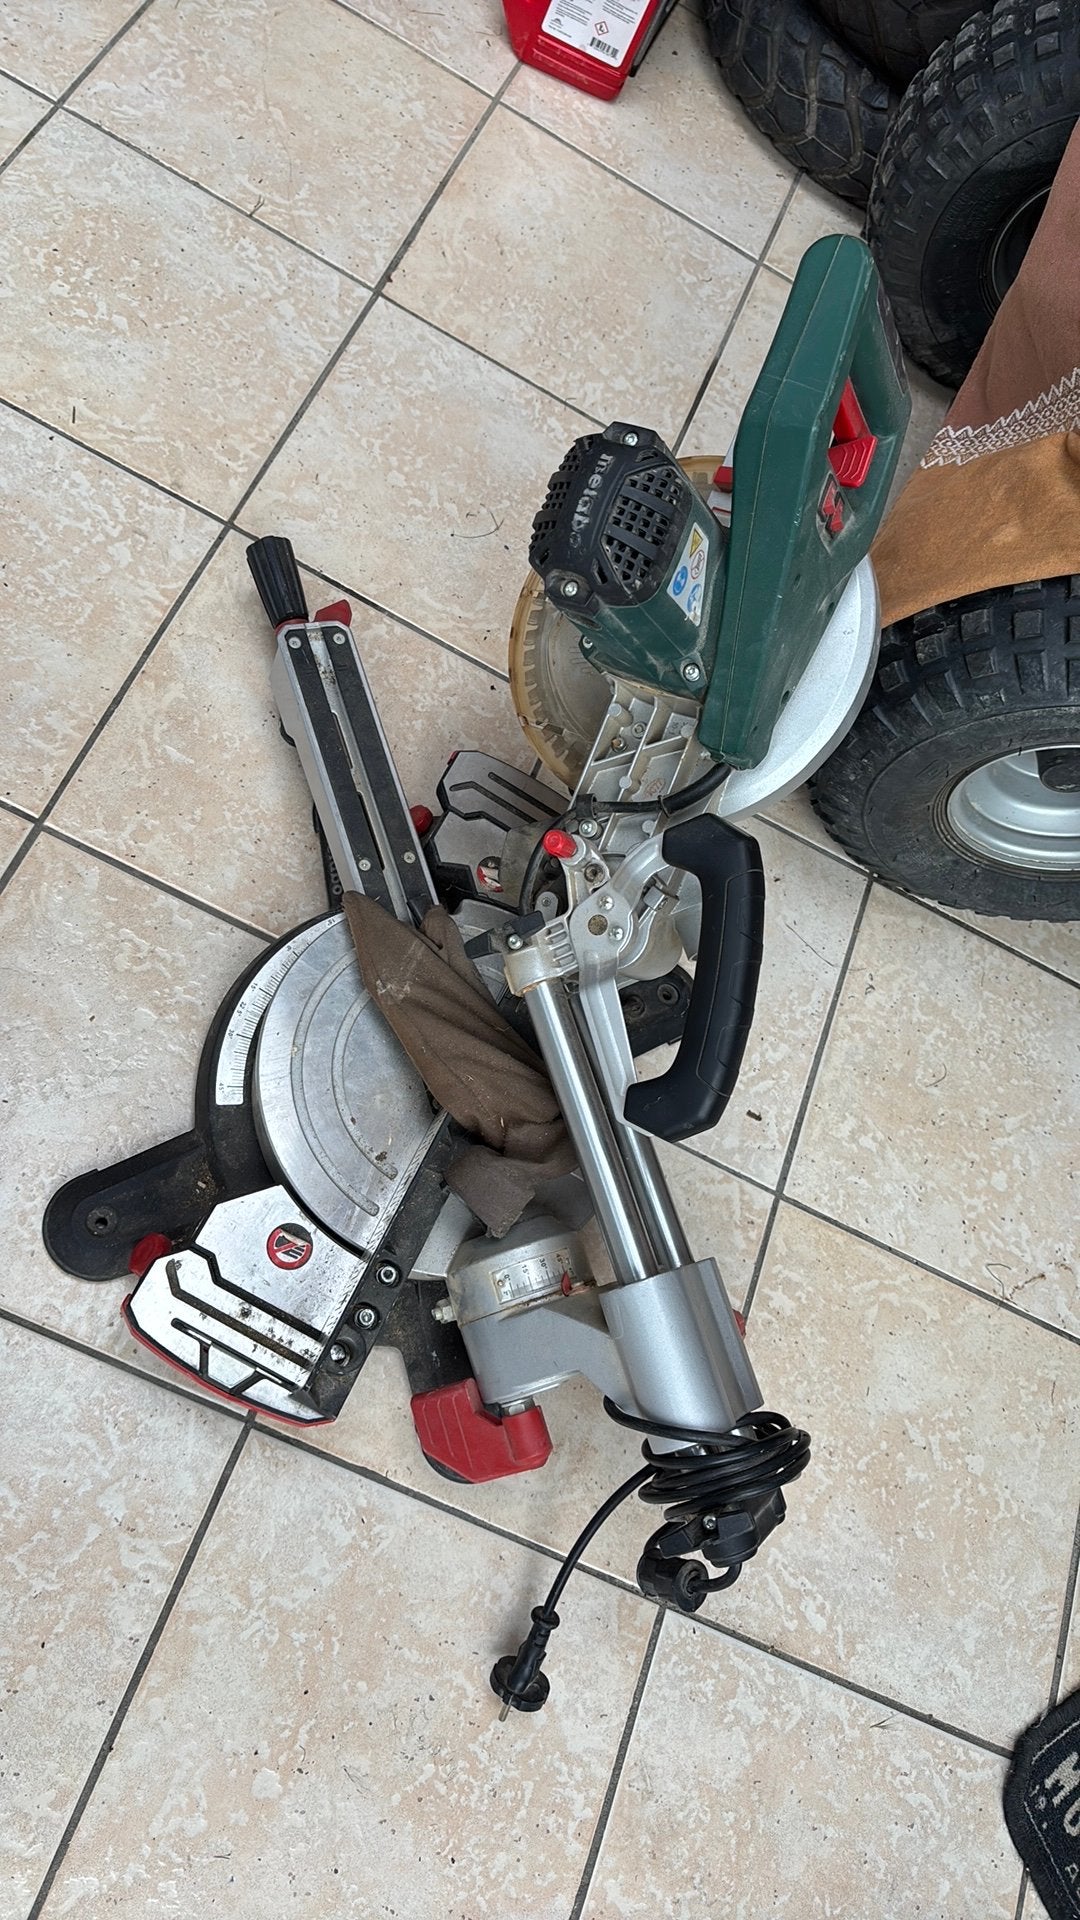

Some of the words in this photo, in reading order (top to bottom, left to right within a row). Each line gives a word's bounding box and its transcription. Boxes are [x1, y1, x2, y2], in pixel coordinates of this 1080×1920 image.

[569, 453, 614, 549] metabo
[539, 1258, 548, 1269] 30°
[521, 1264, 530, 1275] 15°
